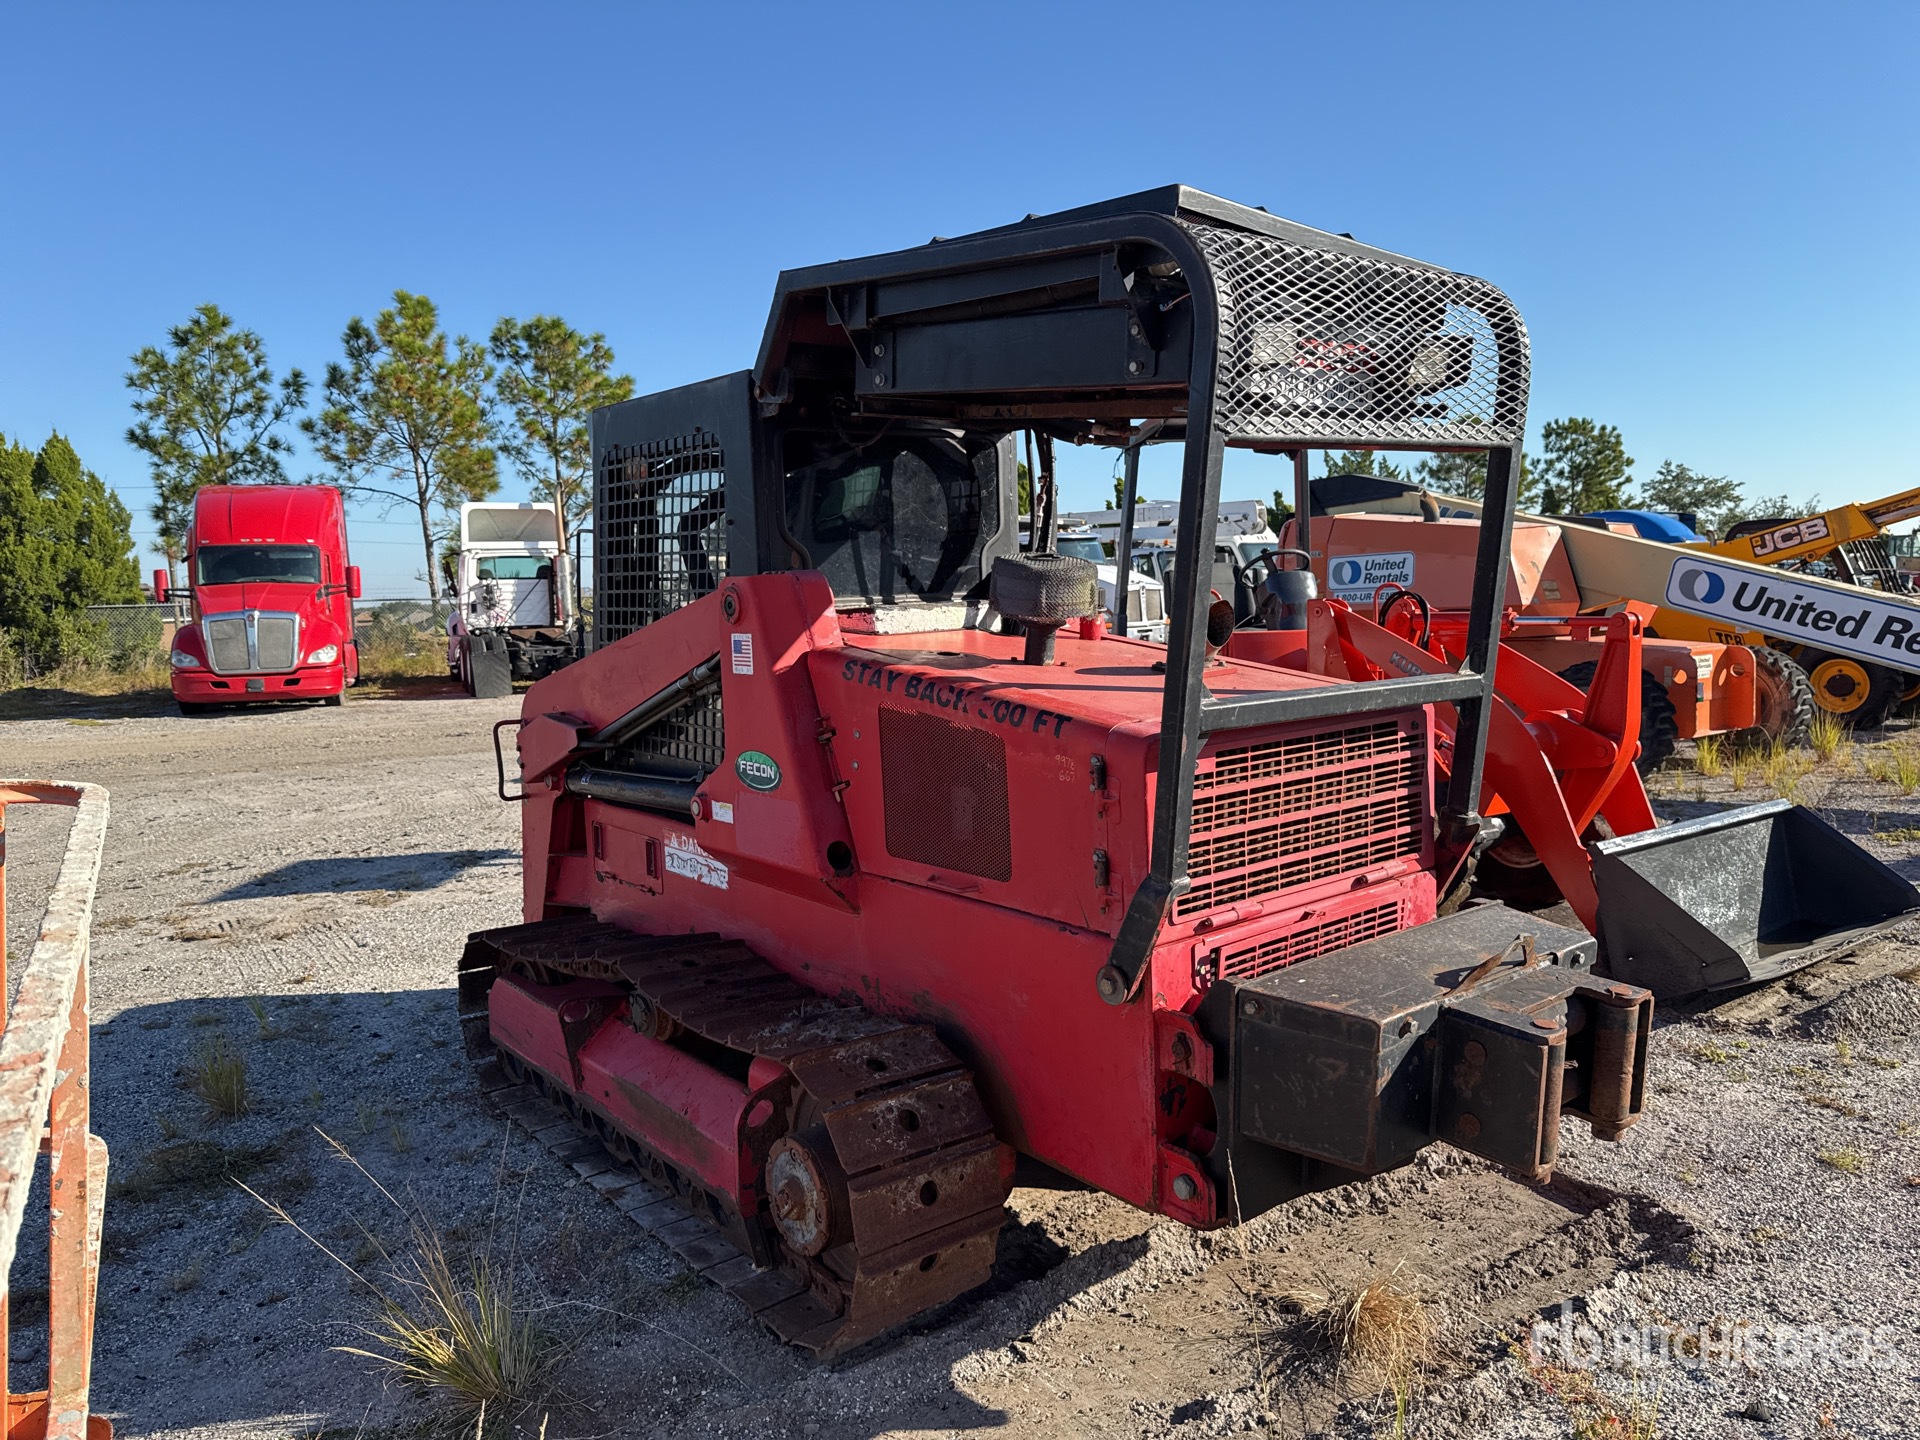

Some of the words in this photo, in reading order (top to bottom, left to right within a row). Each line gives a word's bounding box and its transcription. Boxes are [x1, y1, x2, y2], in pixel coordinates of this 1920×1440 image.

[1754, 517, 1829, 556] JCB
[1363, 571, 1409, 584] Rentals
[1364, 558, 1406, 571] United
[1732, 581, 1872, 639] United
[842, 660, 903, 691] STAY
[904, 675, 975, 714] BACK
[1032, 709, 1073, 739] FT
[740, 760, 775, 779] FECON
